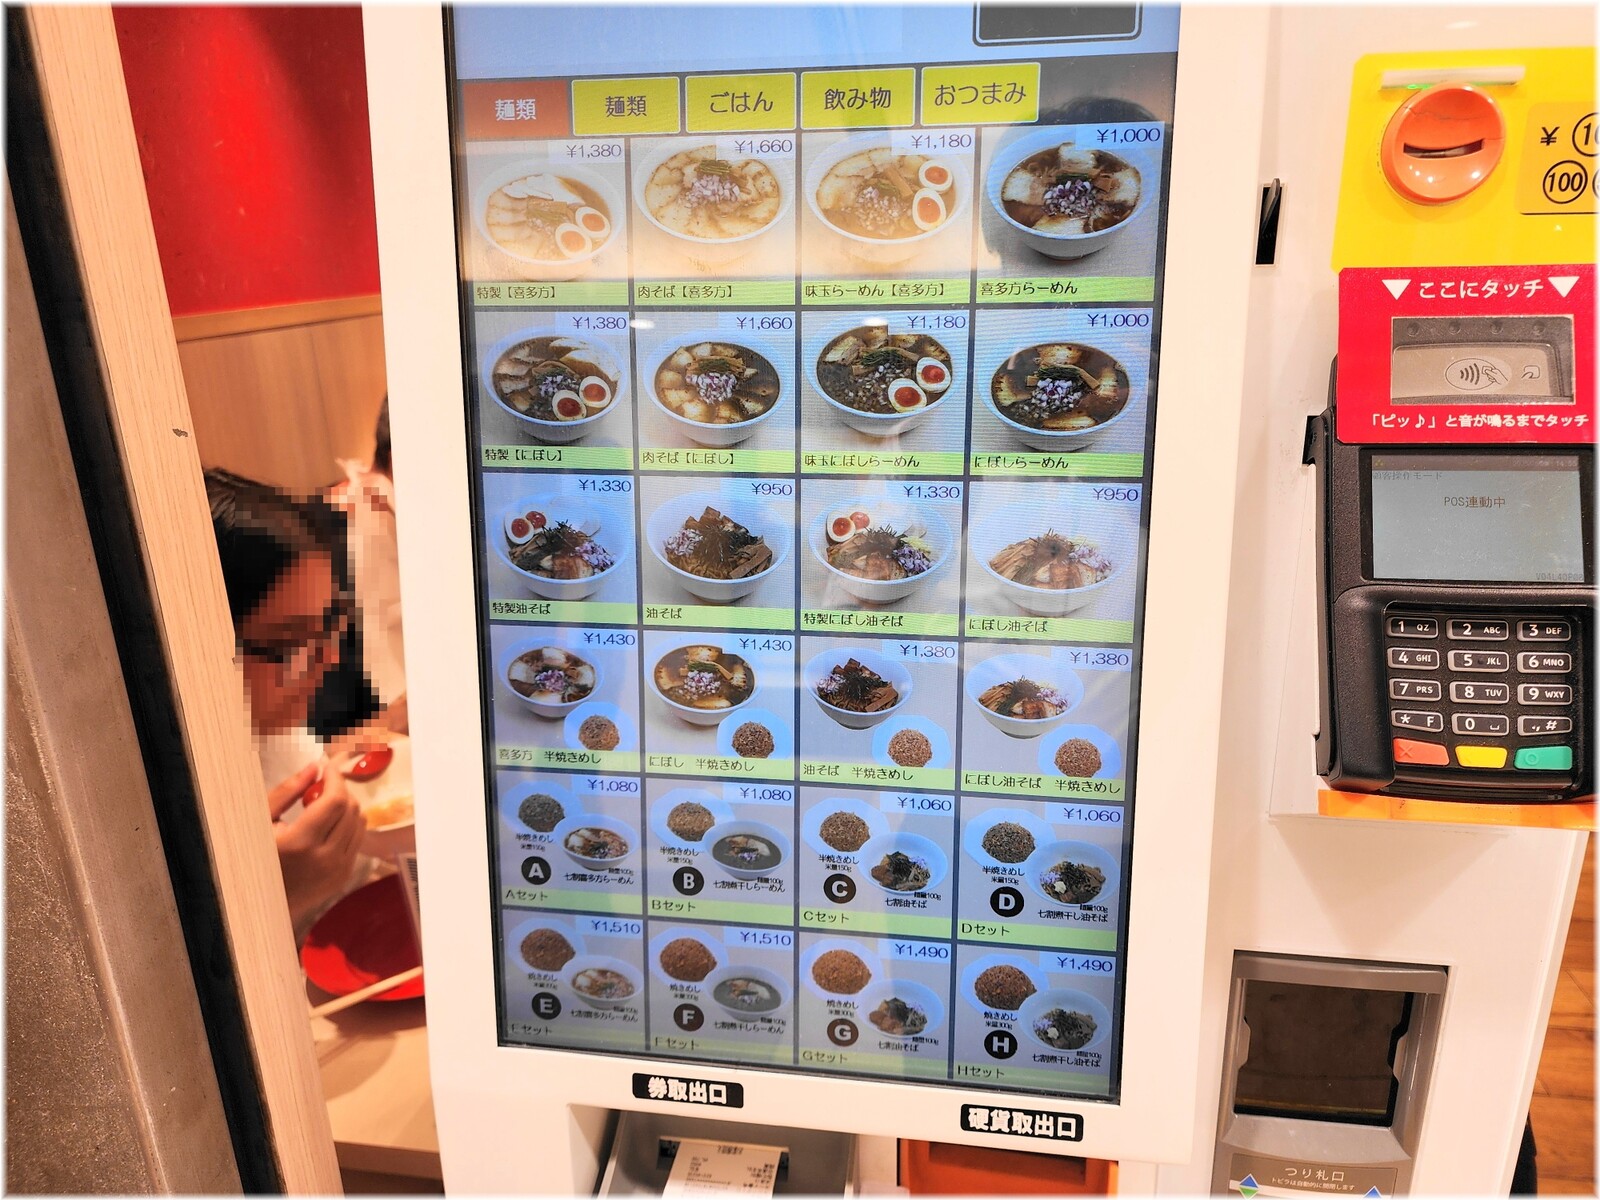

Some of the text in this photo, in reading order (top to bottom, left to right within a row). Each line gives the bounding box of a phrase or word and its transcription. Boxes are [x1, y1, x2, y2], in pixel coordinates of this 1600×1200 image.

[823, 87, 892, 111] 飲み物
[934, 81, 1027, 107] おつまみ
[495, 99, 537, 121] 麺類
[605, 95, 647, 118] 麺類
[709, 91, 774, 114] ごはん
[911, 133, 972, 150] ¥1,180
[1096, 127, 1161, 144] ¥1,000
[566, 143, 622, 159] ¥1,380
[734, 139, 793, 155] ¥1,660
[1548, 172, 1583, 193] 100
[477, 285, 557, 300] 特製【喜多方】
[637, 284, 735, 299] 肉そば【喜多方】
[980, 280, 1078, 296] 喜多方らーめん
[1418, 279, 1544, 299] ここにタッチ
[572, 316, 627, 331] ¥1,380
[736, 316, 793, 331] ¥1,660
[907, 315, 966, 330] ¥1,180
[1087, 312, 1149, 328] ¥1,000
[578, 478, 632, 493] ¥1,330
[751, 482, 793, 496] ¥950
[903, 485, 960, 499] ¥1,330
[1443, 496, 1506, 509] POS連動中
[492, 602, 551, 615] 特製油そば
[646, 607, 682, 620] 油そば
[1397, 621, 1430, 633] 1 QZ
[1462, 623, 1501, 636] 2 ABC
[1529, 624, 1562, 637] 3 DEF
[583, 632, 636, 647] ¥1,430
[739, 637, 793, 652] ¥1,430
[899, 643, 956, 658] ¥1,380
[1398, 651, 1432, 664] 4 GHI
[1069, 651, 1129, 666] ¥1,380
[1463, 654, 1501, 667] 5 JKL
[1528, 655, 1564, 668] 6 MNO
[1399, 683, 1433, 695] 7 PRS
[1464, 685, 1503, 698] 8 TUV
[1528, 687, 1565, 700] 9 WXY
[1426, 716, 1435, 727] F
[1465, 718, 1475, 730] 0
[499, 748, 602, 764] 喜多方 半焼きめし
[649, 756, 755, 772] にぼし 半焼きめし
[803, 764, 914, 781] 油そば 半焼きめし
[587, 779, 638, 793] ¥1,080
[1055, 778, 1121, 794] 半焼きめし
[739, 787, 792, 802] ¥1,080
[897, 796, 952, 812] ¥1,060
[1063, 807, 1121, 823] ¥1,060
[528, 862, 545, 879] A
[683, 872, 695, 889] B
[505, 889, 548, 901] Aセット
[831, 880, 848, 897] C
[651, 899, 696, 912] Bセット
[998, 893, 1016, 910] D
[803, 910, 849, 924] Cセット
[591, 920, 641, 935] ¥1,510
[961, 923, 1010, 936] Dセット
[740, 931, 792, 946] ¥1,510
[895, 943, 949, 959] ¥1,490
[1056, 956, 1114, 973] ¥1,490
[540, 998, 554, 1013] E
[682, 1009, 695, 1024] F
[834, 1024, 852, 1041] G
[992, 1036, 1010, 1053] H
[957, 1064, 1005, 1079] Hセット
[647, 1076, 727, 1104] 券取出口
[968, 1107, 1076, 1138] 硬貨取出口
[1285, 1167, 1345, 1182] つり札口
